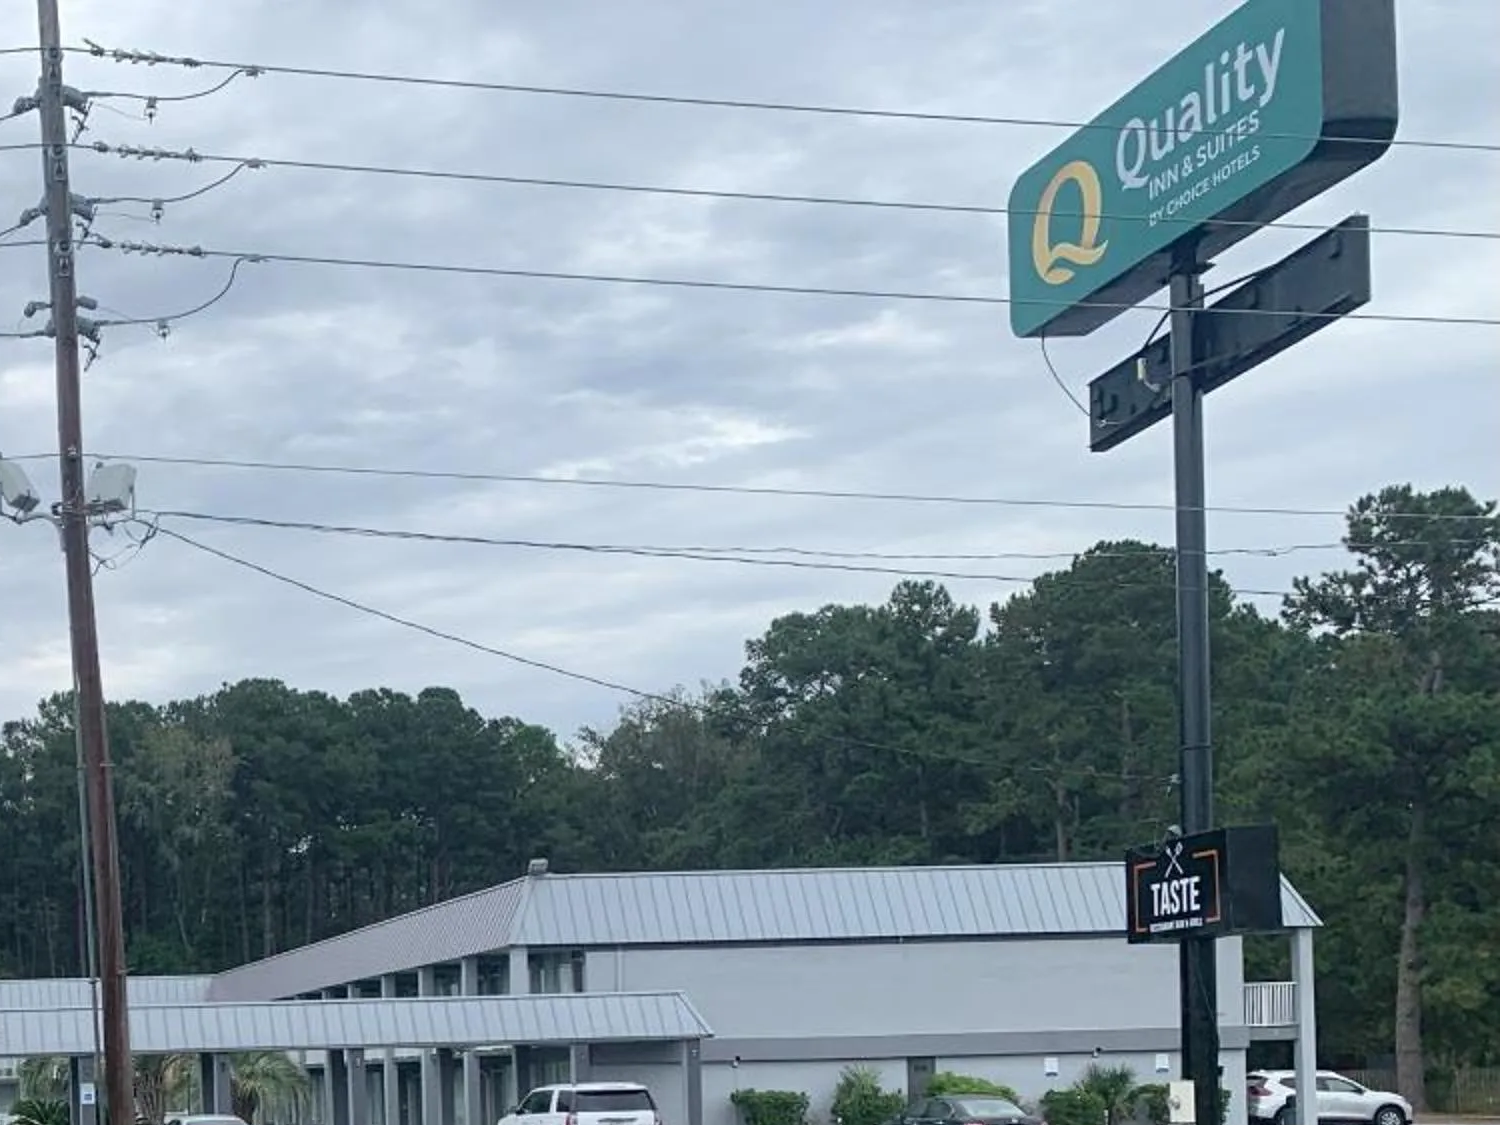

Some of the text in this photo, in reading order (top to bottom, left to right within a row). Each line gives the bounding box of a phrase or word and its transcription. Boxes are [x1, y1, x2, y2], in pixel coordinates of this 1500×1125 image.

[1116, 27, 1285, 190] Quality
[1149, 110, 1260, 200] INN & SUITES
[1149, 145, 1261, 228] BY CHOICE HOTELS
[1032, 160, 1108, 285] Q
[1151, 876, 1201, 917] TASTE
